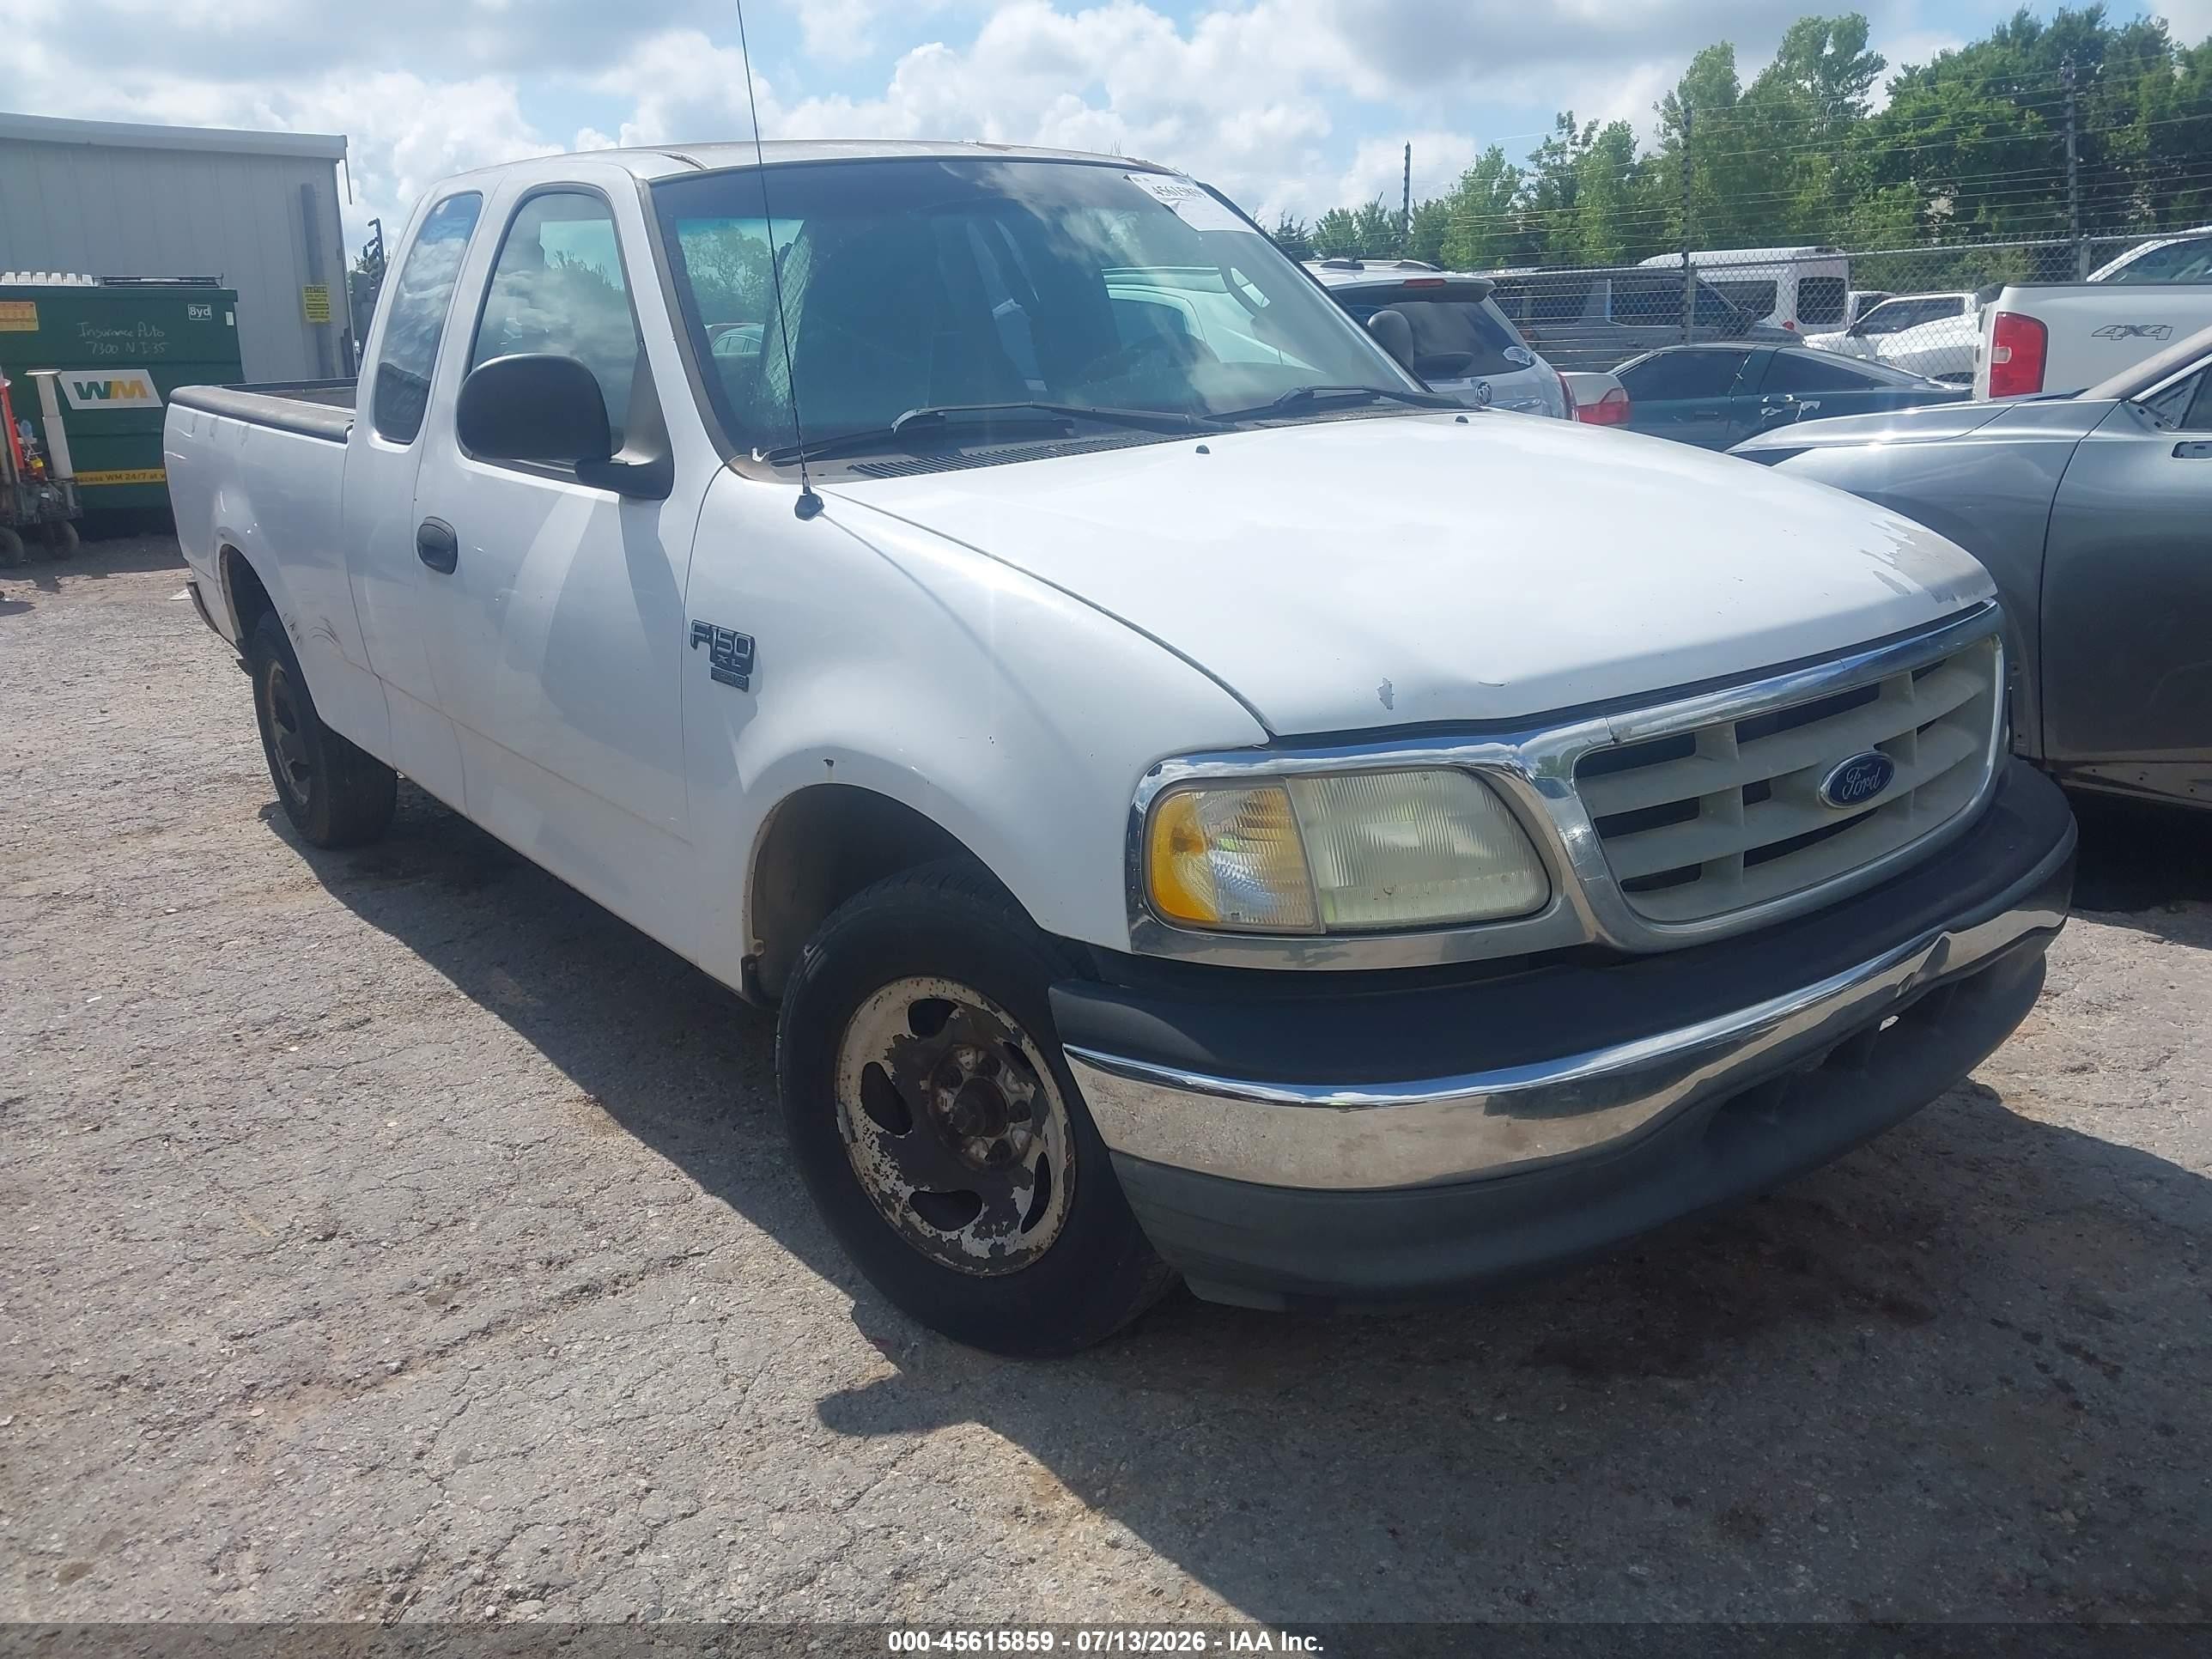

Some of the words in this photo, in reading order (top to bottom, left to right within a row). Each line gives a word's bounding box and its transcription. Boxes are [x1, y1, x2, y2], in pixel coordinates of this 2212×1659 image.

[189, 306, 210, 318] 8yd
[76, 322, 134, 338] Insurance
[137, 321, 166, 337] Auto
[85, 341, 118, 356] 7300
[125, 342, 135, 353] N
[73, 380, 148, 400] WM
[105, 473, 124, 482] WM
[125, 472, 147, 481] 24/7
[690, 620, 752, 659] F-150
[716, 653, 744, 668] XL
[1842, 763, 1882, 800] Ford
